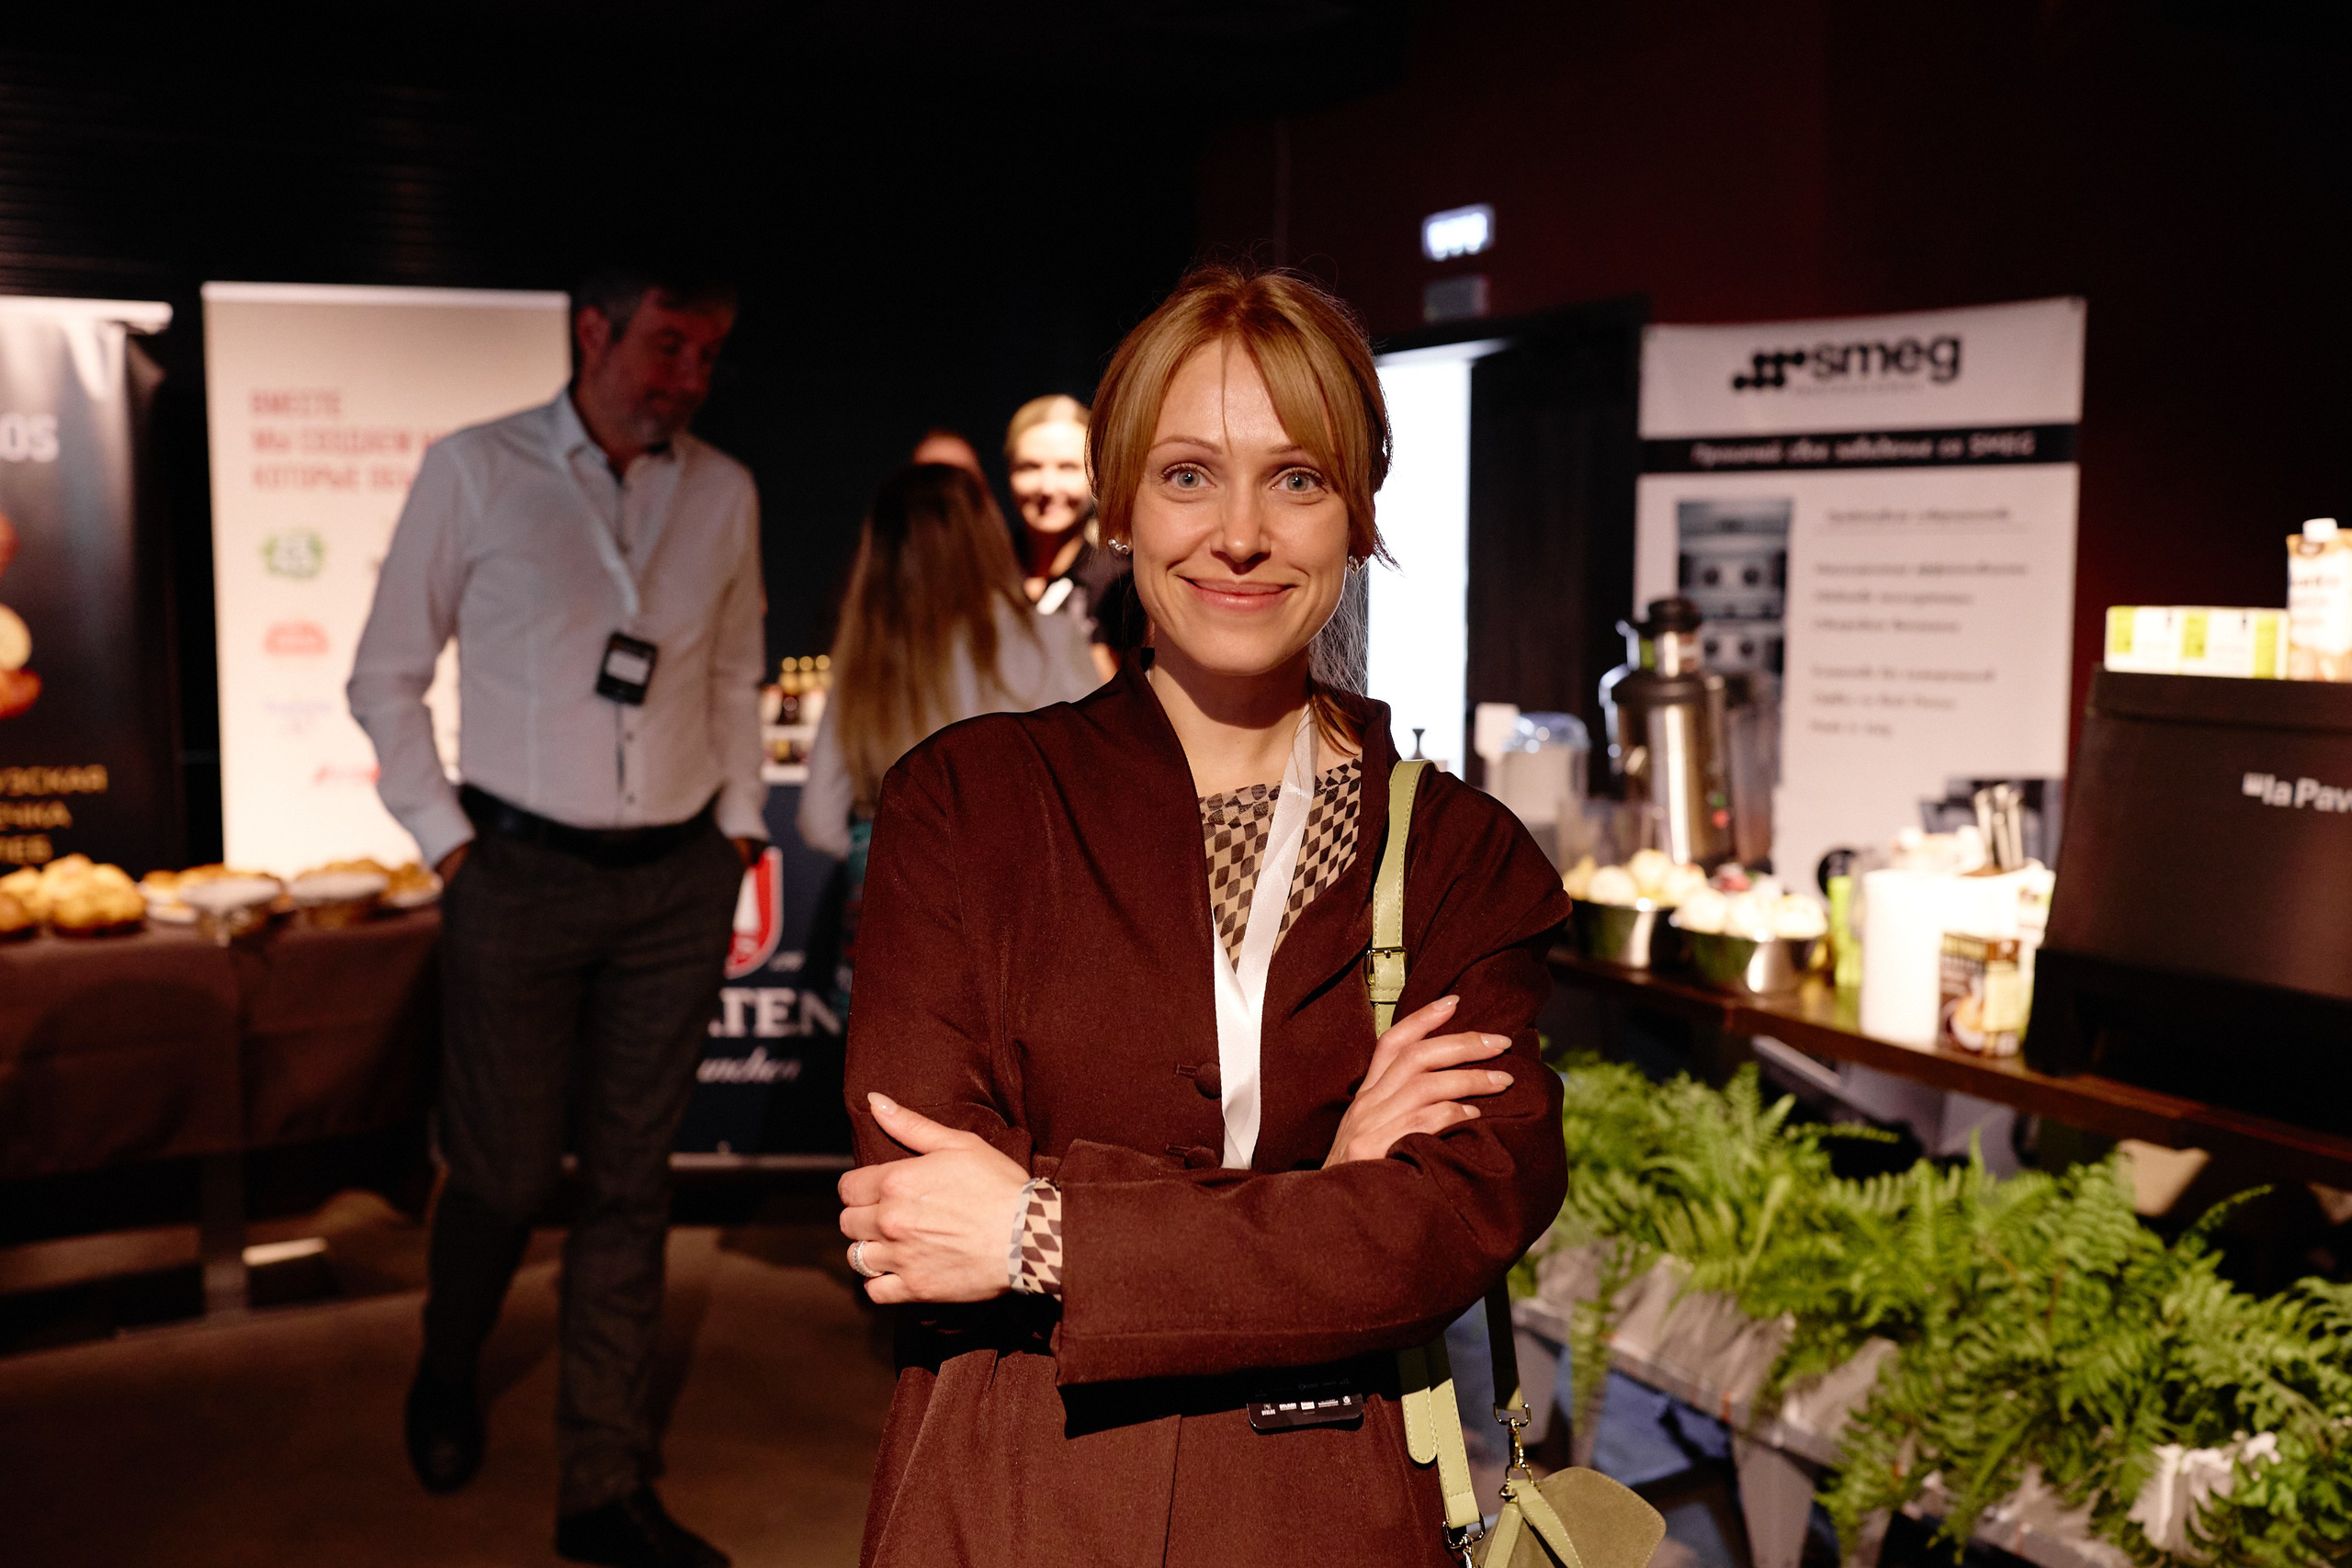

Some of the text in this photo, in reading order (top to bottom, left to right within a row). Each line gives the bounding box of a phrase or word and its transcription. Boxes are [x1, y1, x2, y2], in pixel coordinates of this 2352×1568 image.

[1812, 336, 1961, 384] smeg
[1967, 430, 2035, 457] SMEG
[2262, 773, 2352, 813] la Pav
[707, 987, 842, 1038] TEN
